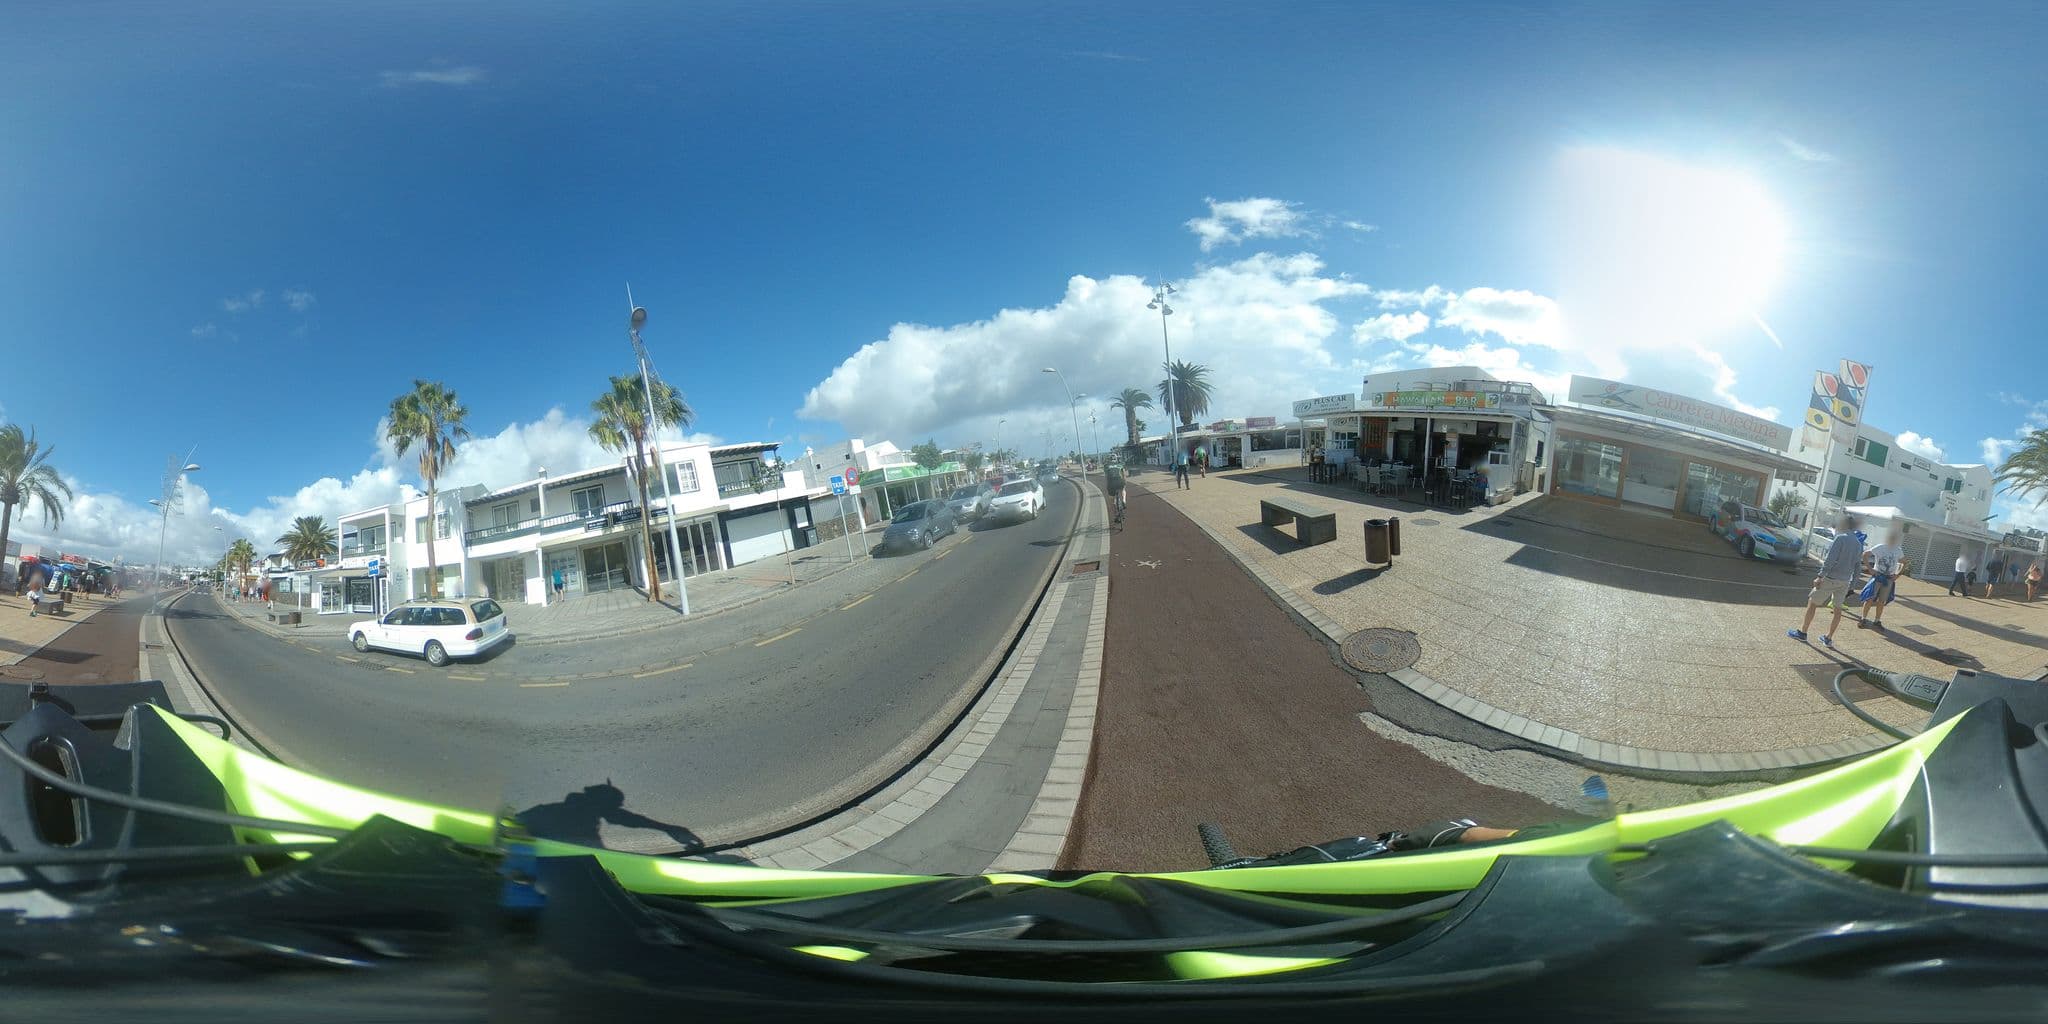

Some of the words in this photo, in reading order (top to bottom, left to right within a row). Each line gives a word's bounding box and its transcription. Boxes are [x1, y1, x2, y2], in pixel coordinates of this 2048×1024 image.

[1455, 395, 1477, 406] BAR
[1645, 390, 1713, 420] Cabrera
[1719, 407, 1778, 438] Medina
